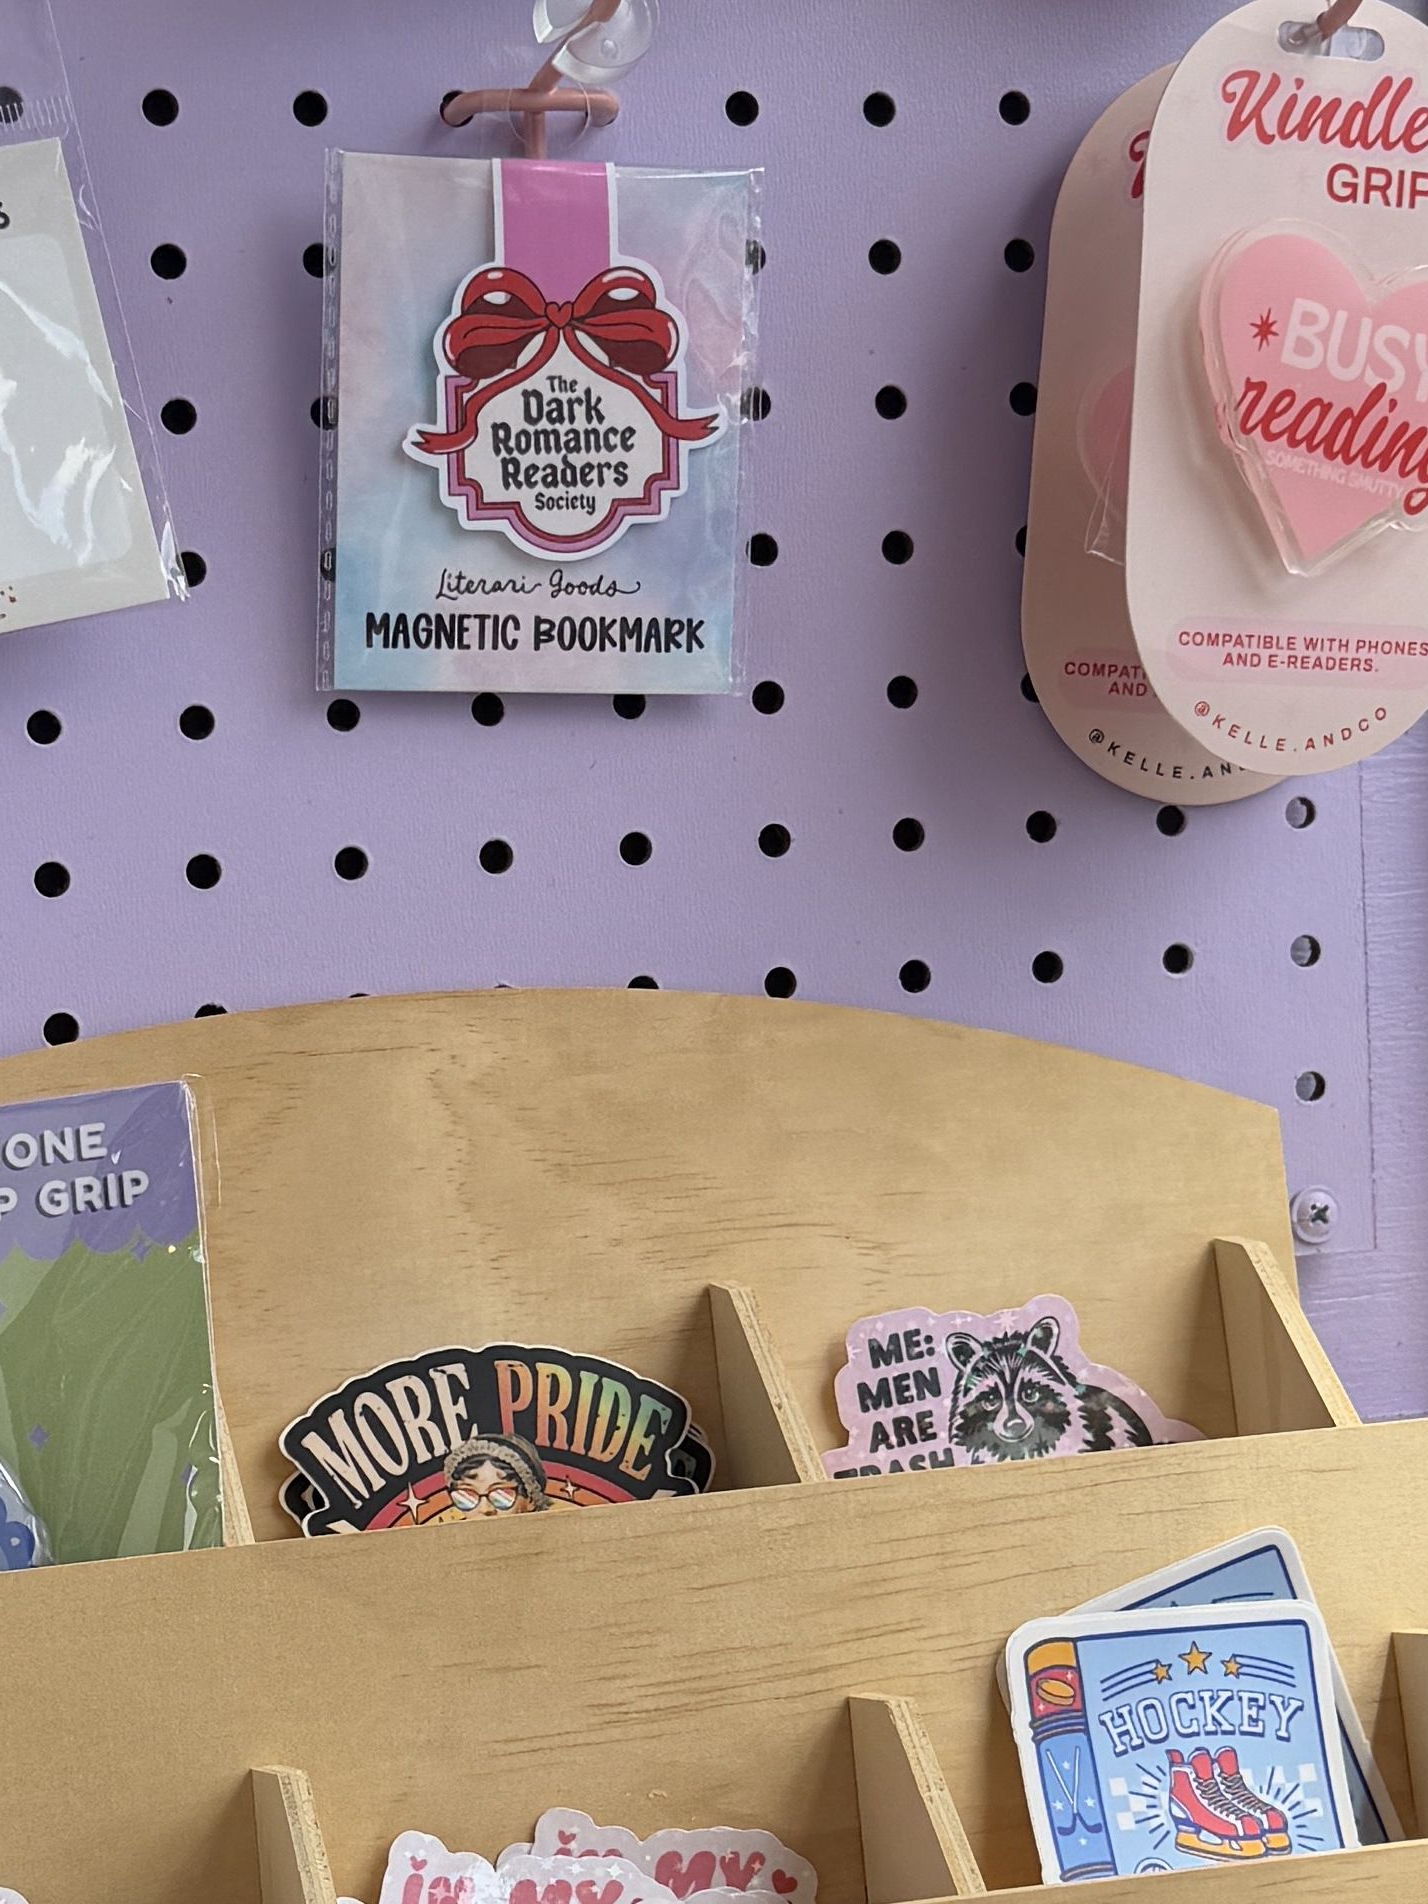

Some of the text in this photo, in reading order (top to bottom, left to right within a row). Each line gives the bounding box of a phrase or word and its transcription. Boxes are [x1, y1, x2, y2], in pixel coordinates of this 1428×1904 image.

[545, 374, 578, 394] The
[522, 387, 606, 427] Dark
[491, 422, 637, 458] Romance
[501, 455, 630, 491] Readers
[534, 491, 597, 516] Society
[365, 611, 705, 654] MAGNETIC BOOKMARK
[1178, 631, 1297, 651] COMPATIBLE
[1303, 637, 1349, 653] WITH
[1222, 653, 1380, 673] AND E-READERS.
[1108, 681, 1147, 697] AND
[36, 1169, 151, 1219] GRIP
[867, 1327, 935, 1369] ME:
[856, 1366, 942, 1414] MEN
[301, 1359, 673, 1509] MORE PRIDE
[869, 1411, 938, 1454] ARE
[1100, 1689, 1305, 1759] HOCKEY
